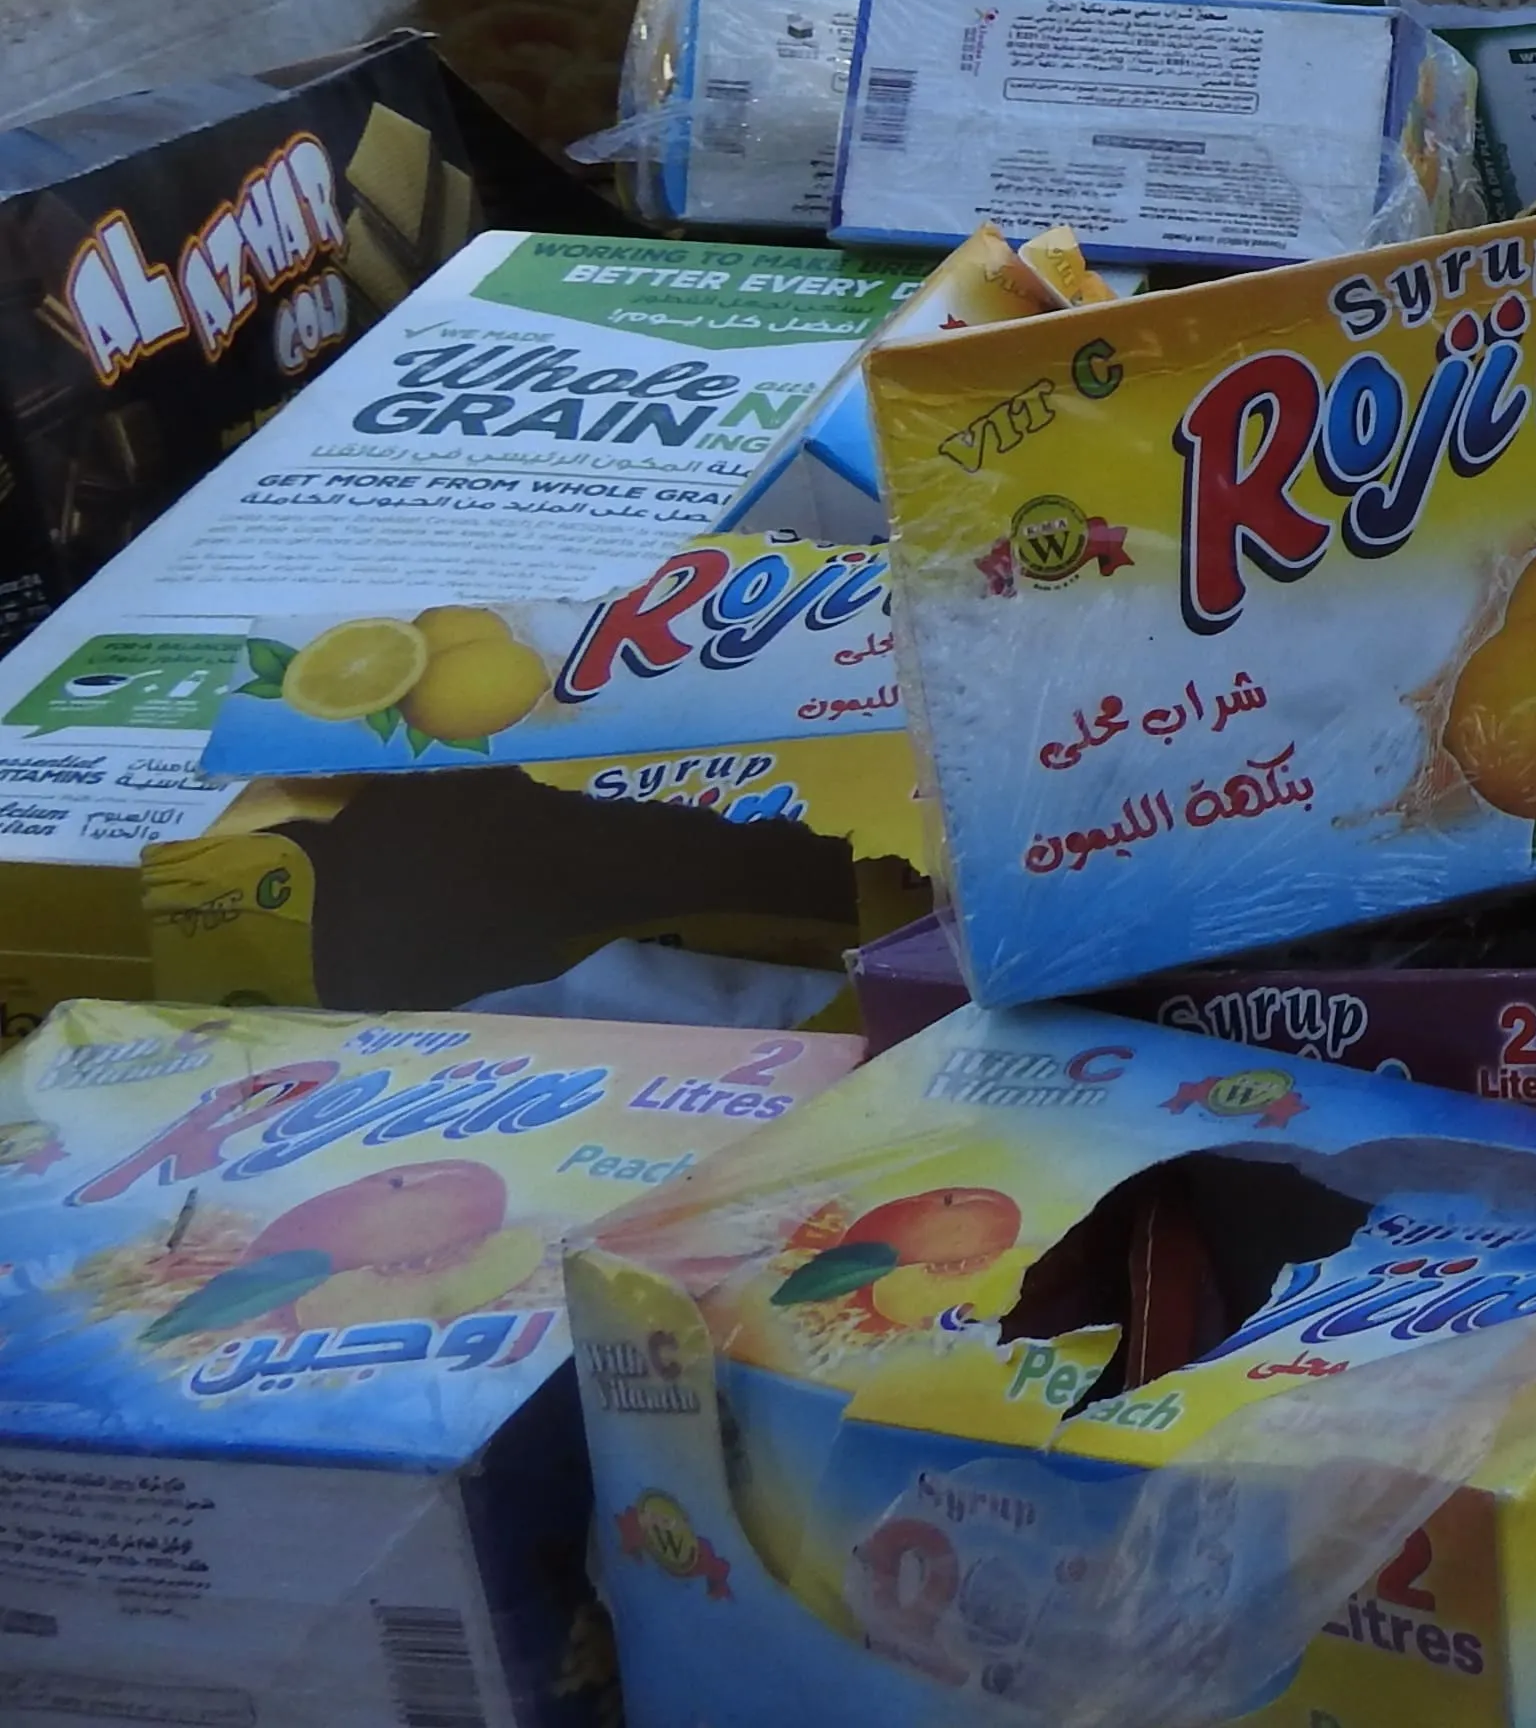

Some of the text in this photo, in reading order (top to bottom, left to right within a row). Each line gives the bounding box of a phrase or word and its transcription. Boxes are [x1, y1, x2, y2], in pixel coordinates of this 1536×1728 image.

[179, 132, 347, 362] AZHAR
[533, 241, 690, 264] WORKING
[702, 249, 743, 268] TO
[755, 252, 846, 273] MAKE
[67, 210, 190, 384] AL
[563, 264, 884, 299] BETTER EVERY
[438, 327, 554, 344] WE MADE
[393, 342, 741, 402] Whole
[352, 391, 719, 447] GRAIN
[939, 338, 1124, 473] VIT C
[258, 474, 648, 500] GET MORE FROM WHOLE
[1030, 534, 1072, 568] W
[1139, 673, 1268, 741] شراب
[593, 754, 774, 799] Syrup
[1025, 745, 1315, 874] بنكهة الليمون
[341, 1026, 471, 1056] Syrup
[1158, 986, 1368, 1052] Syrup
[731, 1038, 805, 1086] 2
[937, 1045, 1137, 1084] With C
[627, 1076, 796, 1119] Litres
[926, 1074, 1107, 1109] Vitamin
[65, 1056, 607, 1207] Rojin
[559, 1144, 697, 1185] Peach
[191, 1309, 560, 1398] روجين
[647, 1330, 684, 1374] C
[1377, 1527, 1437, 1613] 2
